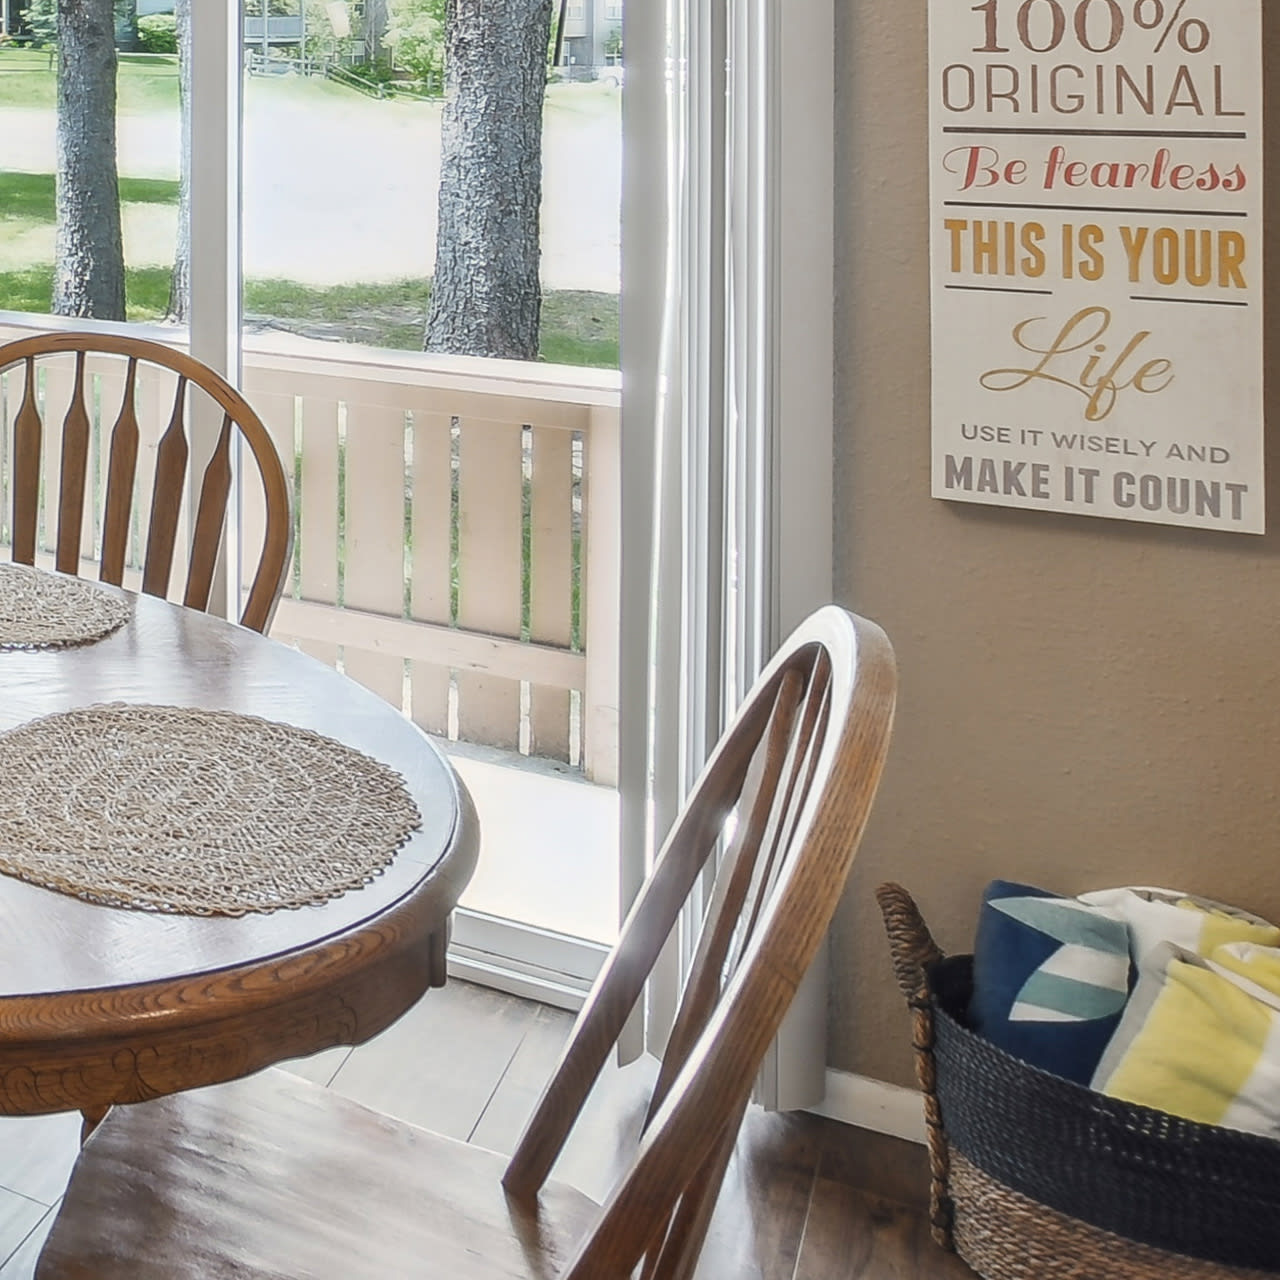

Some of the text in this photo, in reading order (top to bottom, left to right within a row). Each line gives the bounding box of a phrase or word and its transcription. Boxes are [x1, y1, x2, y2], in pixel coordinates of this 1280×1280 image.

[942, 63, 1246, 116] ORIGINAL
[942, 145, 1247, 192] Be fearless
[944, 219, 1248, 289] THIS IS YOUR
[979, 306, 1175, 421] Life
[961, 423, 1230, 464] USE IT WISELY AND
[944, 454, 1248, 520] MAKE IT COUNT
